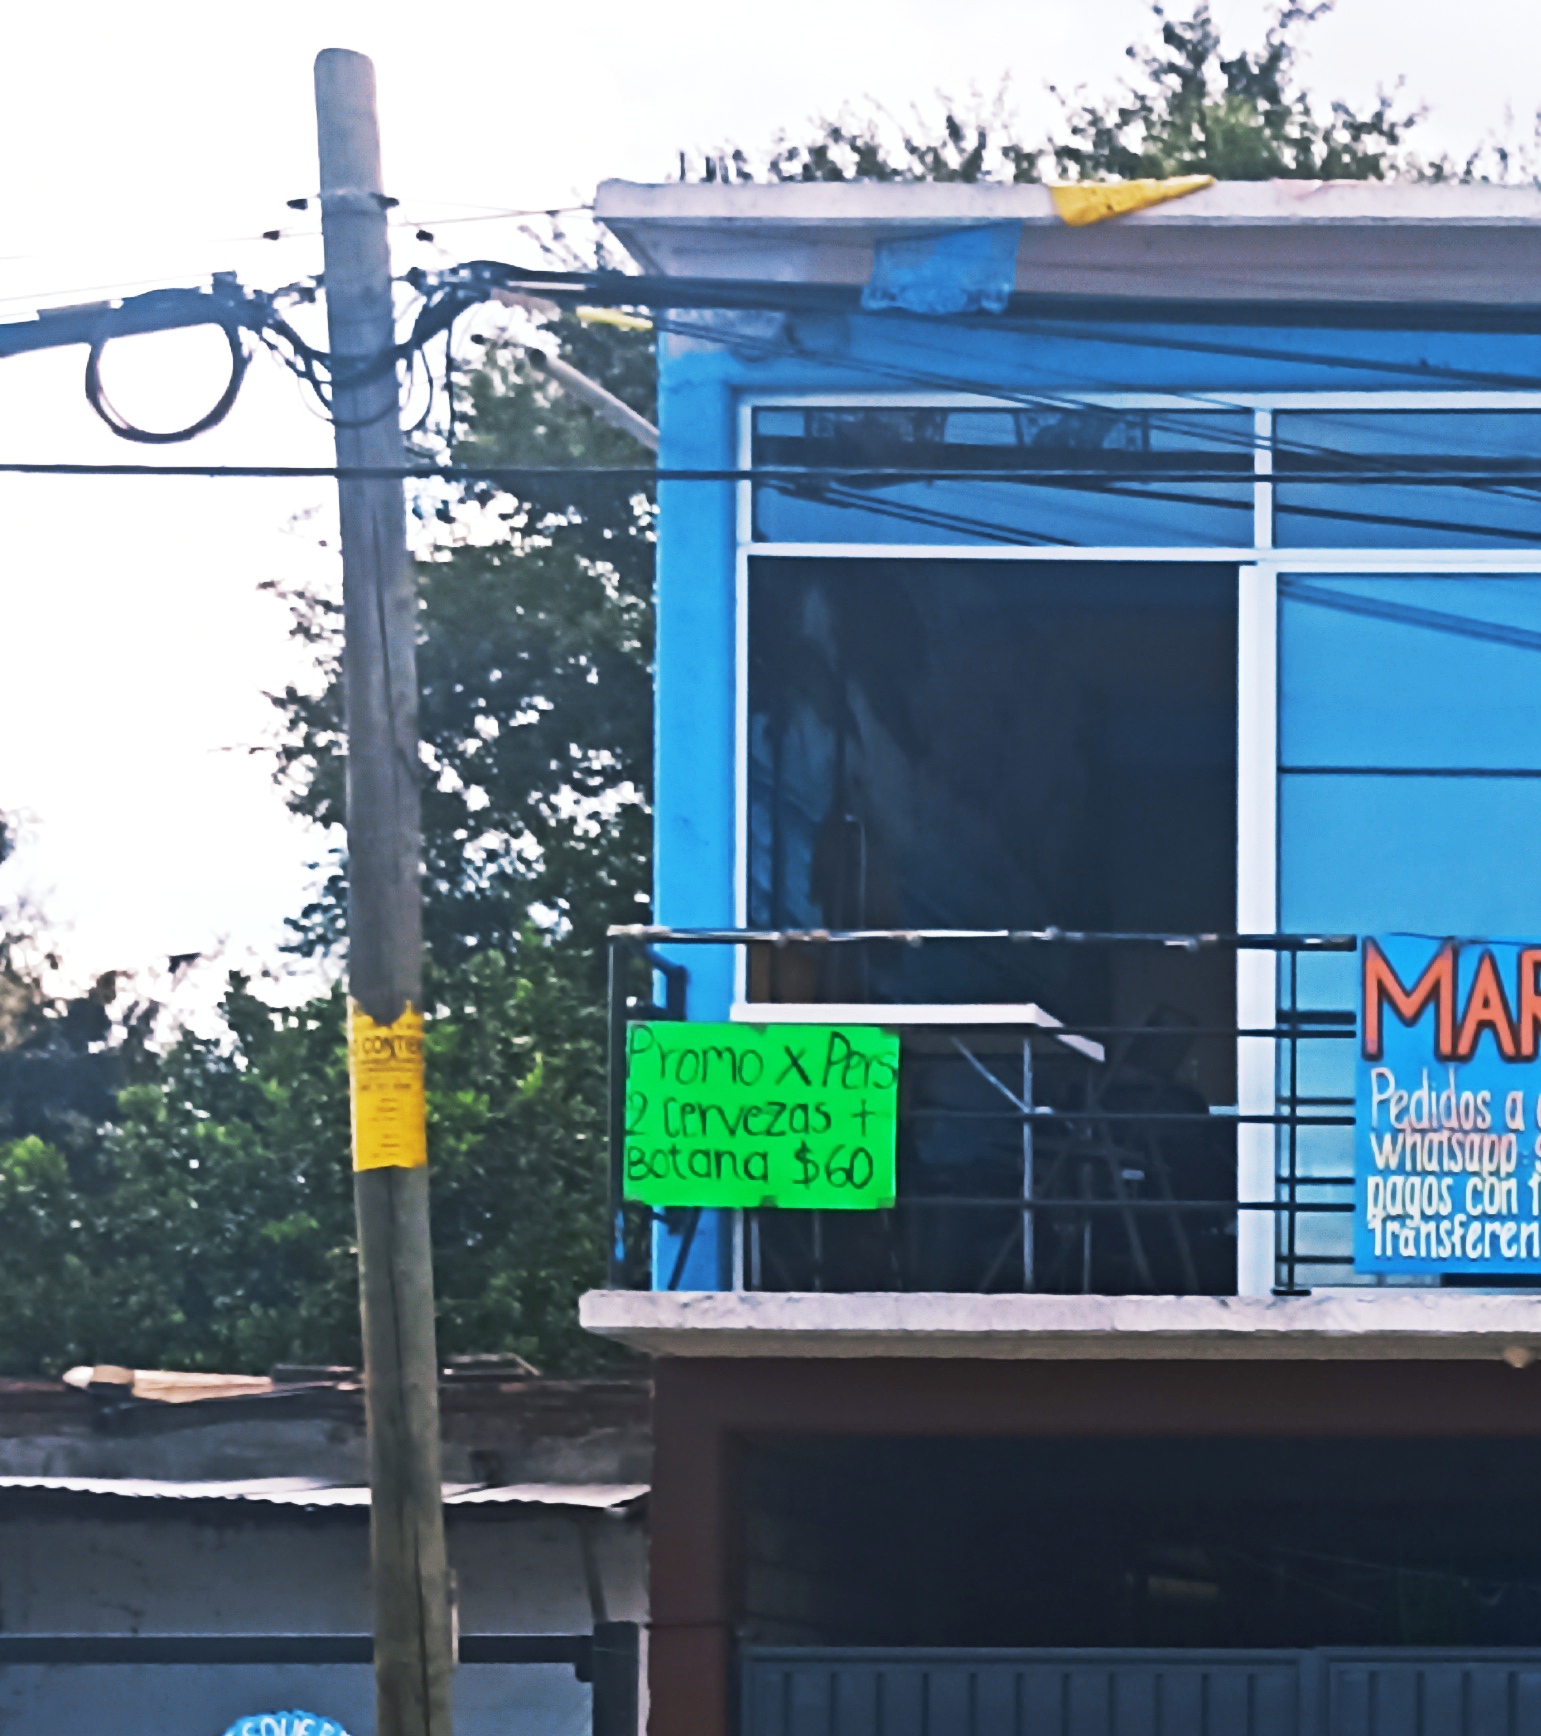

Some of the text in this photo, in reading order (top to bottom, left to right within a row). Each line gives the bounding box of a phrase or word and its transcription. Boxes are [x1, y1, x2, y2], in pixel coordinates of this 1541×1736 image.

[627, 1024, 764, 1087] Promo
[624, 1091, 649, 1136] 2
[1370, 1066, 1492, 1131] Pedidos
[1504, 1090, 1526, 1131] a
[626, 1140, 874, 1189] Botana $60
[1367, 1175, 1453, 1227] pagos
[1465, 1175, 1519, 1217] con
